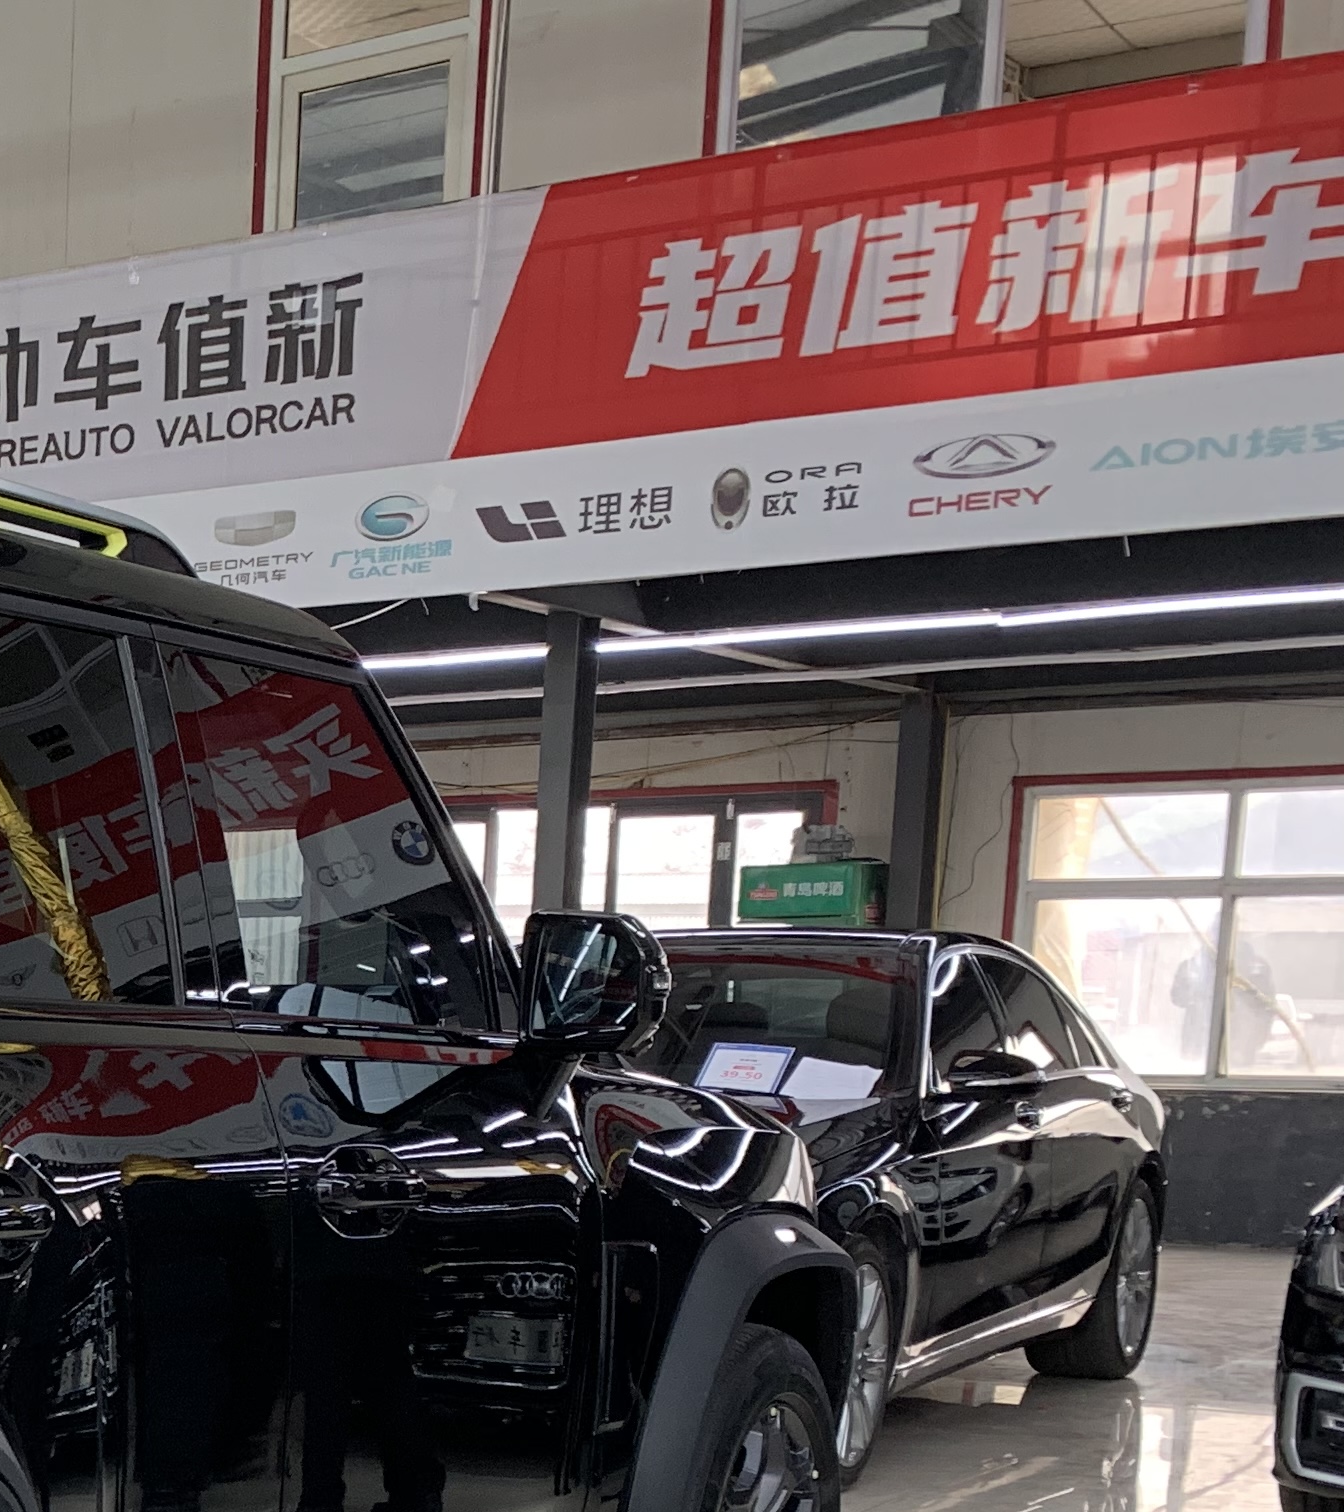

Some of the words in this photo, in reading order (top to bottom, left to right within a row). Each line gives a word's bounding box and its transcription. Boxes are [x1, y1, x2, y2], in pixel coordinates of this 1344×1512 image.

[624, 147, 1344, 379] 超值新车
[156, 393, 356, 448] VALORCAR
[763, 462, 864, 485] ORA
[578, 486, 674, 535] 理想
[762, 484, 860, 518] 欧拉
[907, 484, 1054, 518] CHERY
[193, 551, 315, 573] GEOMETRY
[330, 539, 453, 568] 广汽新能源
[220, 569, 288, 587] 几何汽车
[783, 881, 845, 898] 青岛啤酒
